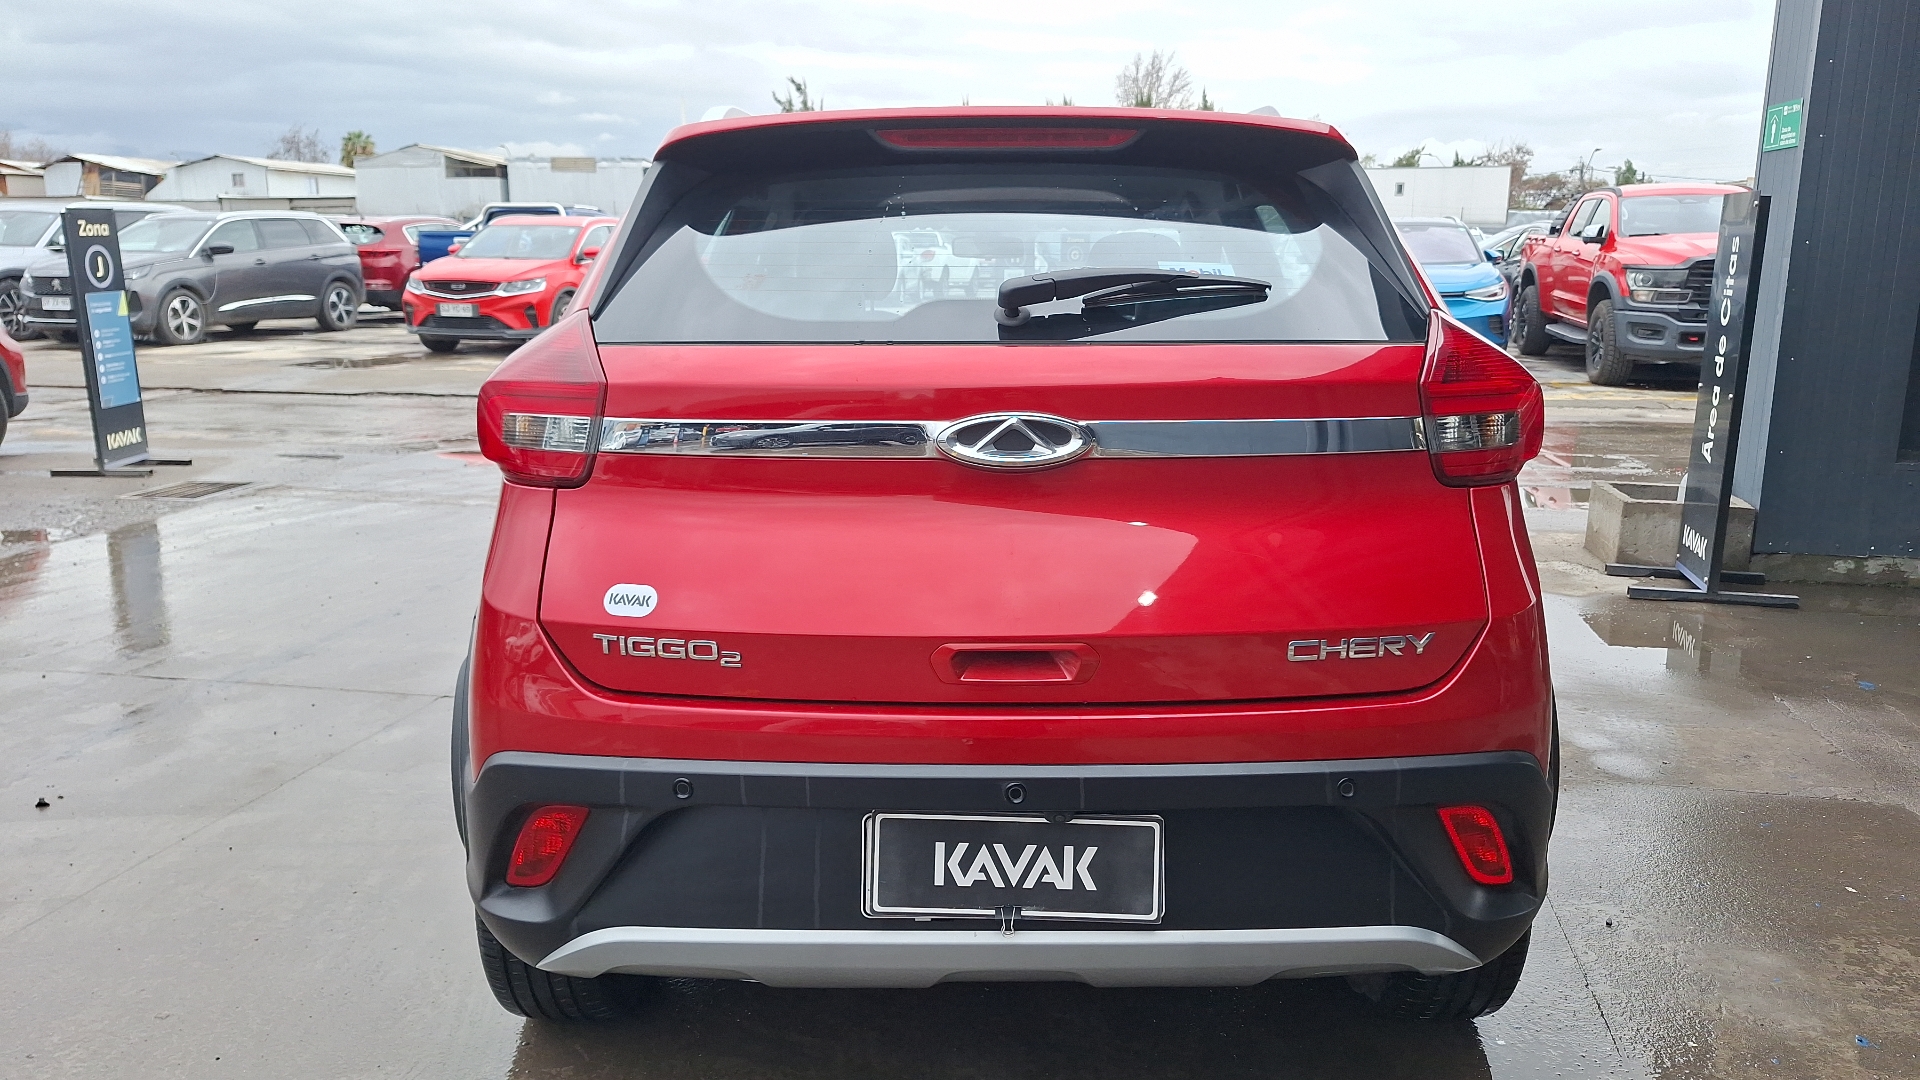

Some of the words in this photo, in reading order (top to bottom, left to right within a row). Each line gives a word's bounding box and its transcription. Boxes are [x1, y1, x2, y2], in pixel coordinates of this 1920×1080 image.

[77, 219, 110, 237] Zona
[96, 255, 105, 278] J
[1720, 235, 1740, 327] Citas
[1714, 334, 1727, 378] de
[106, 426, 143, 451] KAVAK
[1701, 385, 1721, 464] Área
[1682, 523, 1708, 561] KAVAK
[608, 592, 652, 608] KAVAK
[1287, 632, 1436, 662] CHERY
[933, 841, 1099, 891] KAVAK
